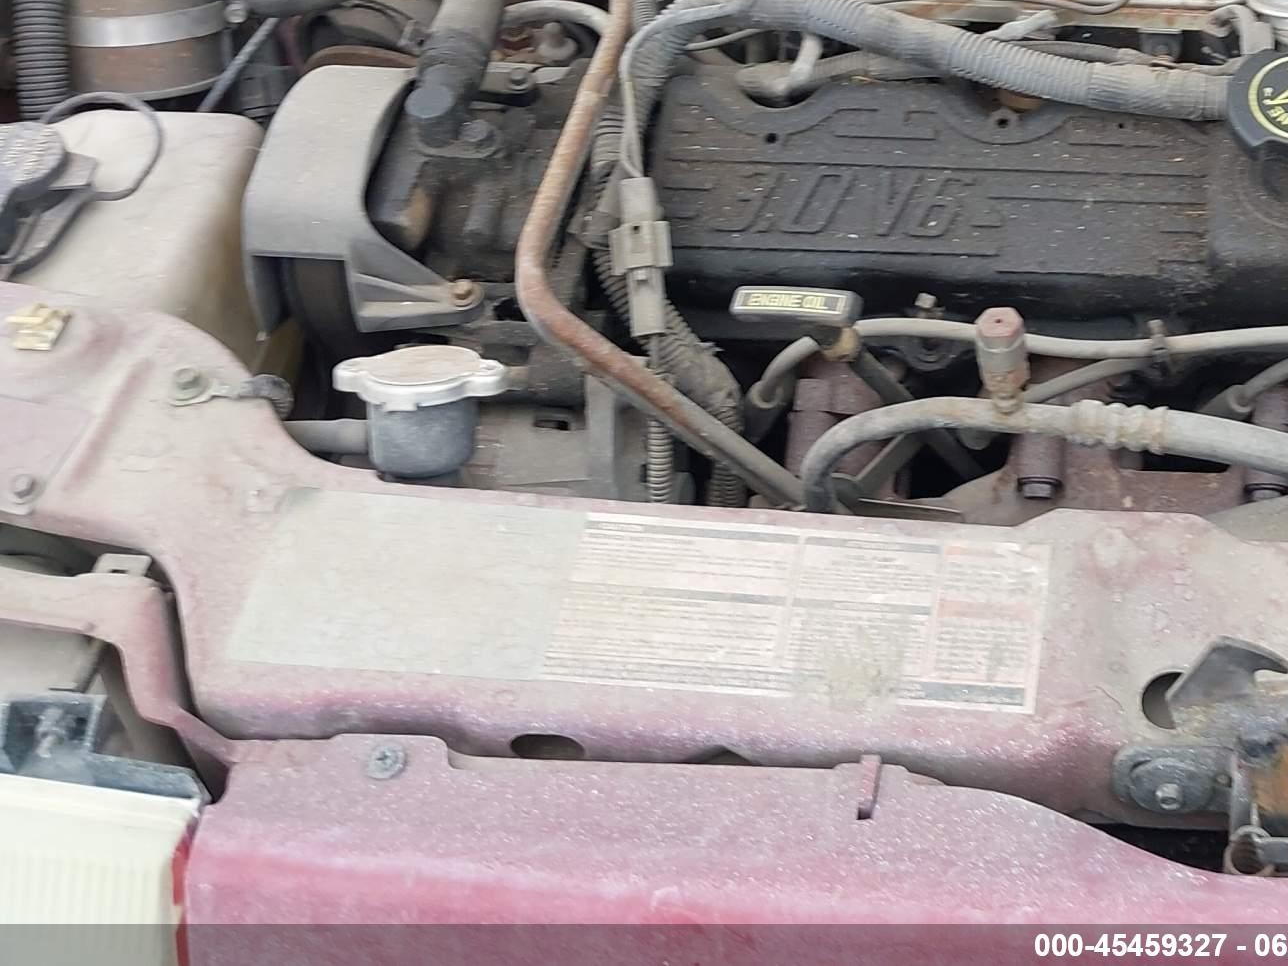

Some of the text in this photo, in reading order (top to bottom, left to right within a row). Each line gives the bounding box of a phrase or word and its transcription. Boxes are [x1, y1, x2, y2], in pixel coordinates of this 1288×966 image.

[865, 172, 975, 238] V6
[747, 293, 829, 310] ENGINE OIL
